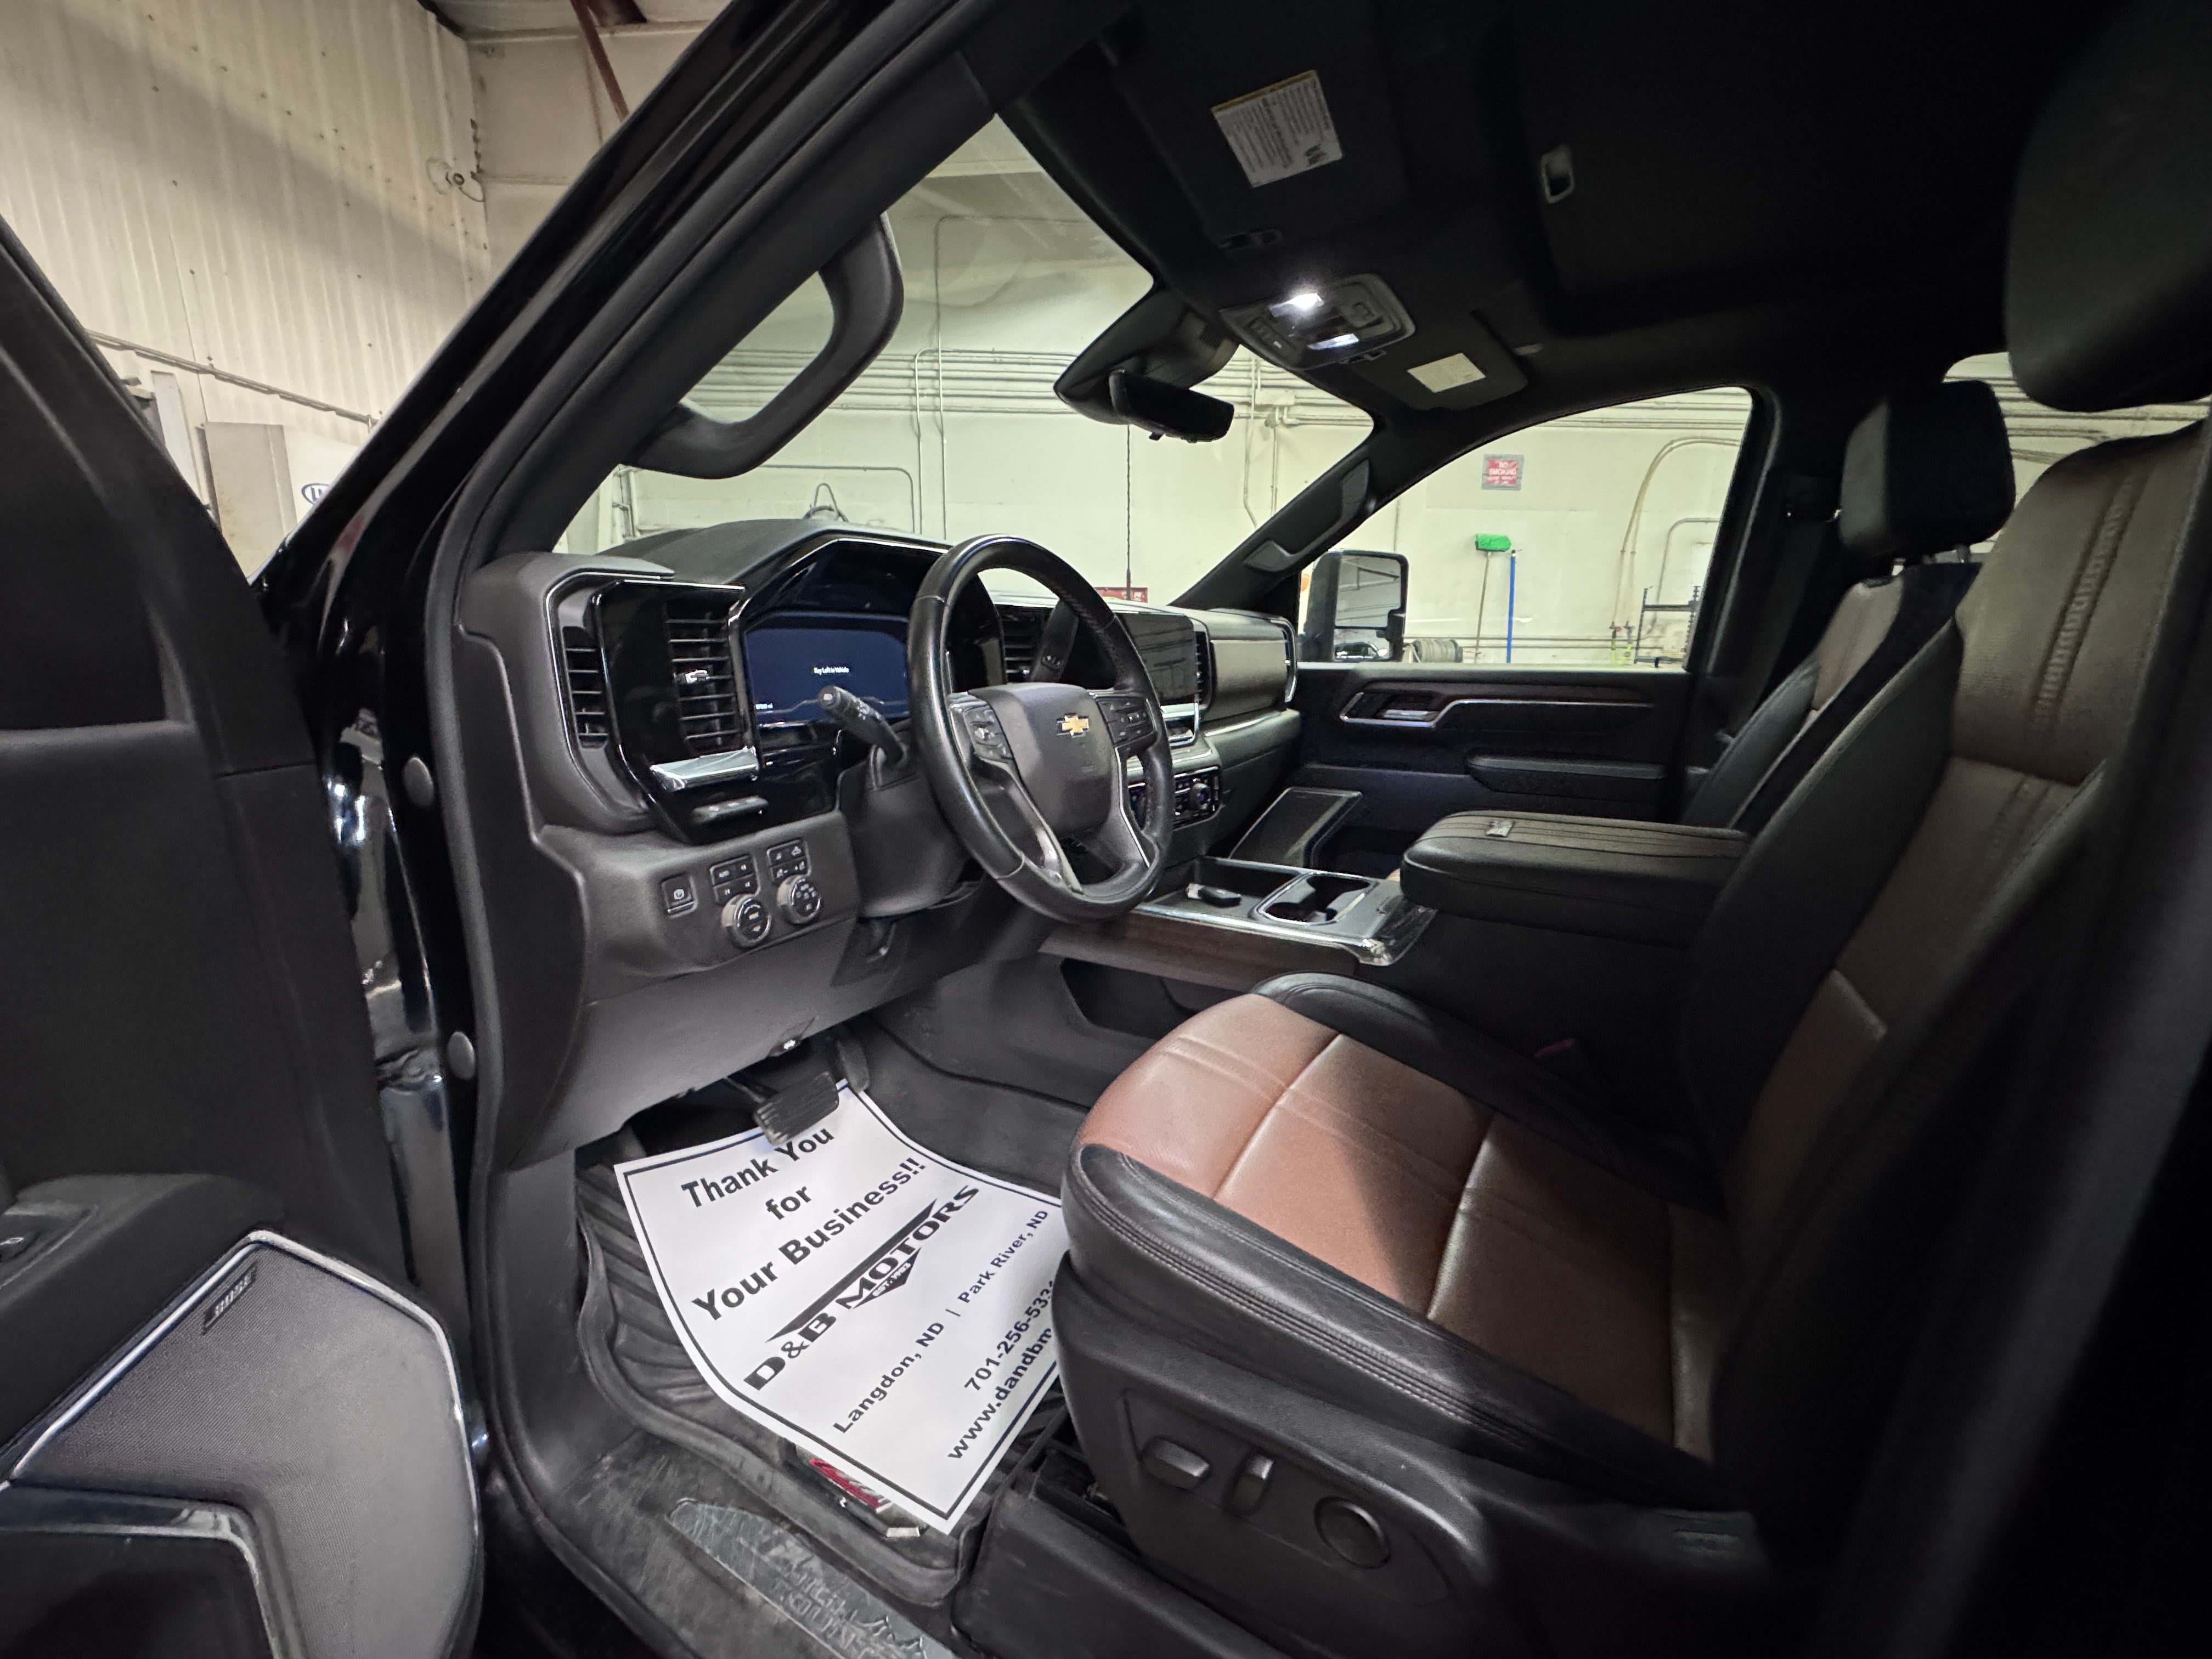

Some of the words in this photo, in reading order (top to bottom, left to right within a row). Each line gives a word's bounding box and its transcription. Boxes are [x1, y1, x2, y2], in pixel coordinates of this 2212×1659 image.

[680, 1158, 779, 1208] Thank
[774, 1127, 835, 1162] You
[692, 1261, 778, 1321] Your
[778, 1157, 926, 1266] Business!!
[765, 1186, 811, 1220] for
[743, 1312, 837, 1391] D&B
[835, 1185, 980, 1310] MOTORS
[833, 1353, 922, 1434] Langdon,
[915, 1322, 945, 1347] ND
[957, 1271, 995, 1304] Park
[990, 1232, 1034, 1268] River,
[1026, 1210, 1048, 1229] ND
